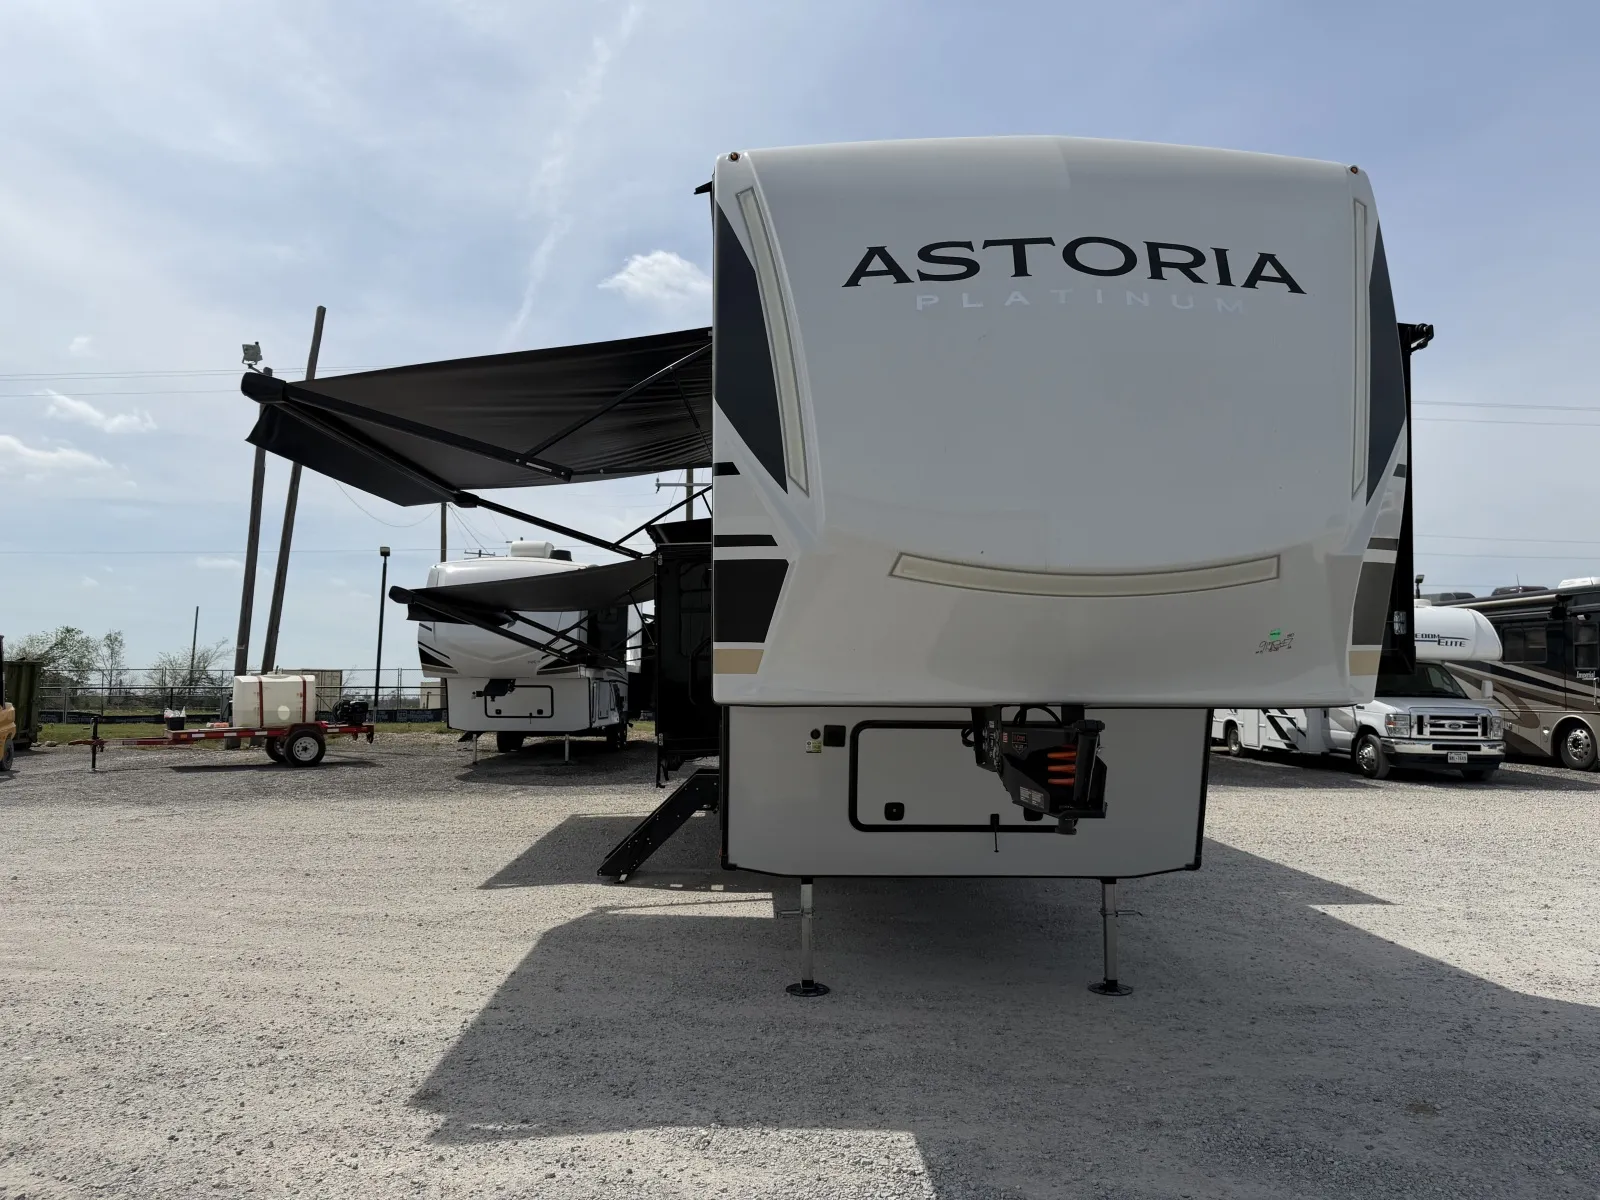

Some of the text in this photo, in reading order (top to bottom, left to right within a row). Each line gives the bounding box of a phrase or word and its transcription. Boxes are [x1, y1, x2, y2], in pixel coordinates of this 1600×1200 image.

[842, 236, 1306, 294] ASTORIA
[915, 288, 1245, 315] PLATINUM
[1438, 639, 1466, 647] ELITE
